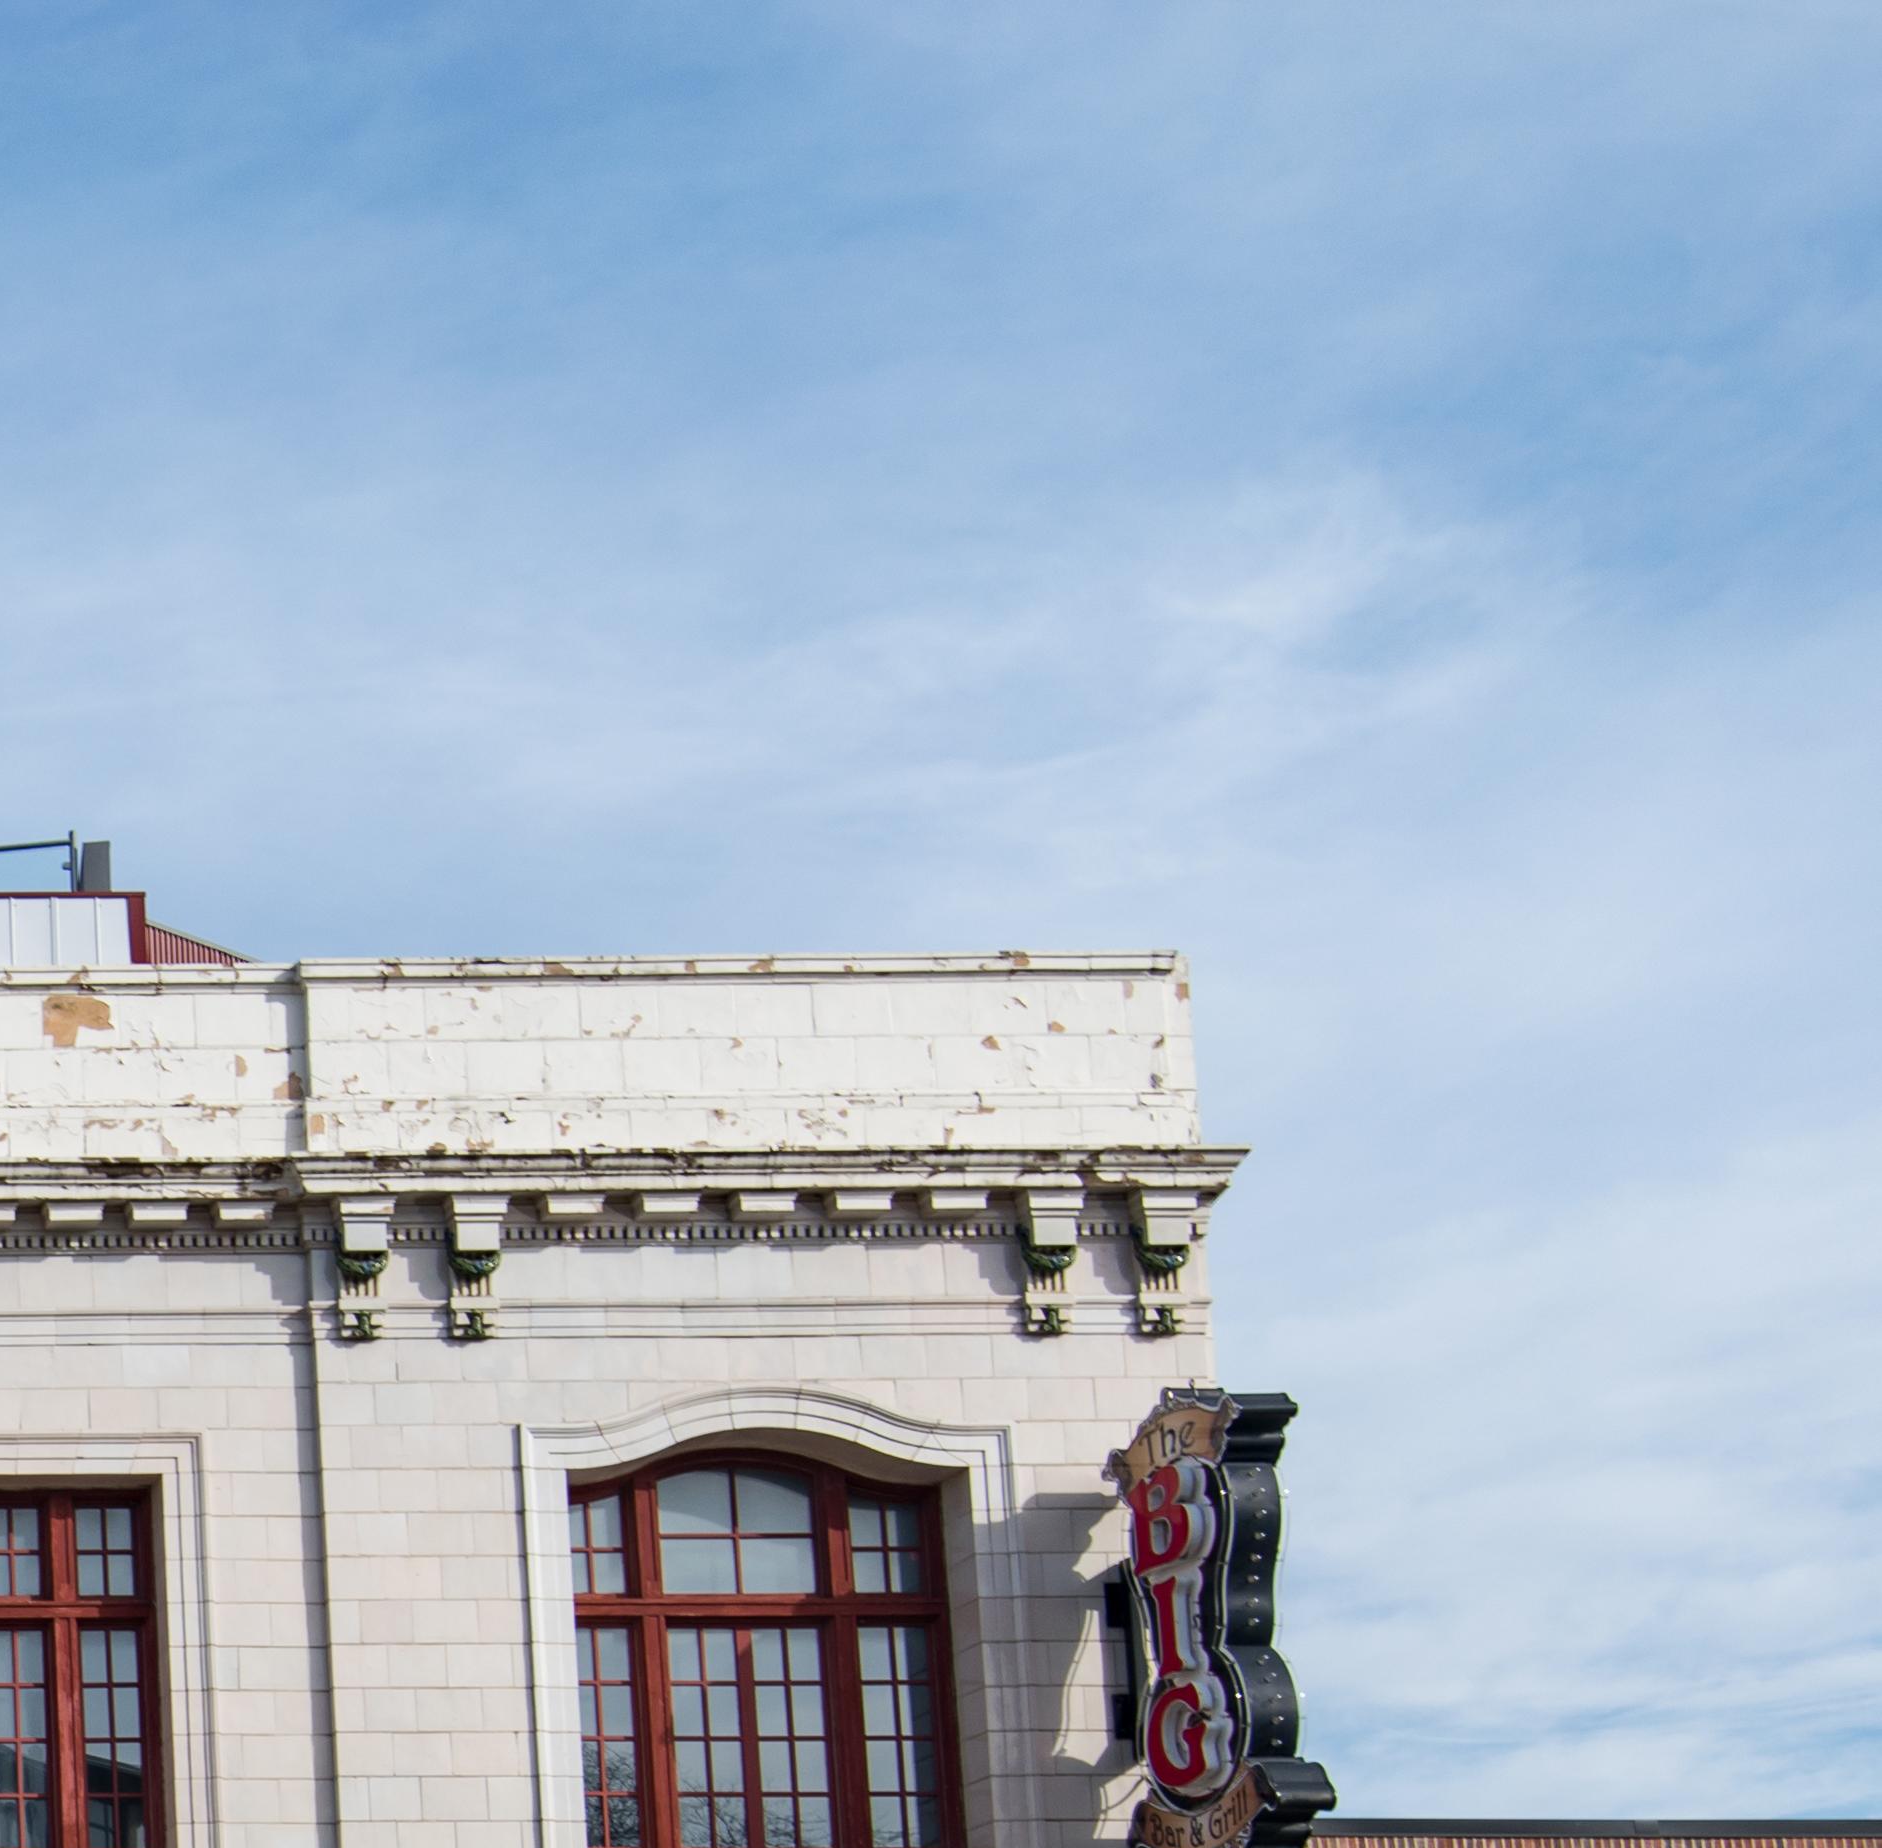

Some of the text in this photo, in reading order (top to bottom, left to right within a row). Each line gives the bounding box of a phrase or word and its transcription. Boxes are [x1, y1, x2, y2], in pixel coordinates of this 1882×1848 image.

[1138, 1421, 1196, 1466] The
[1128, 1465, 1212, 1787] BIG
[1149, 1786, 1250, 1848] Bar & Grill
